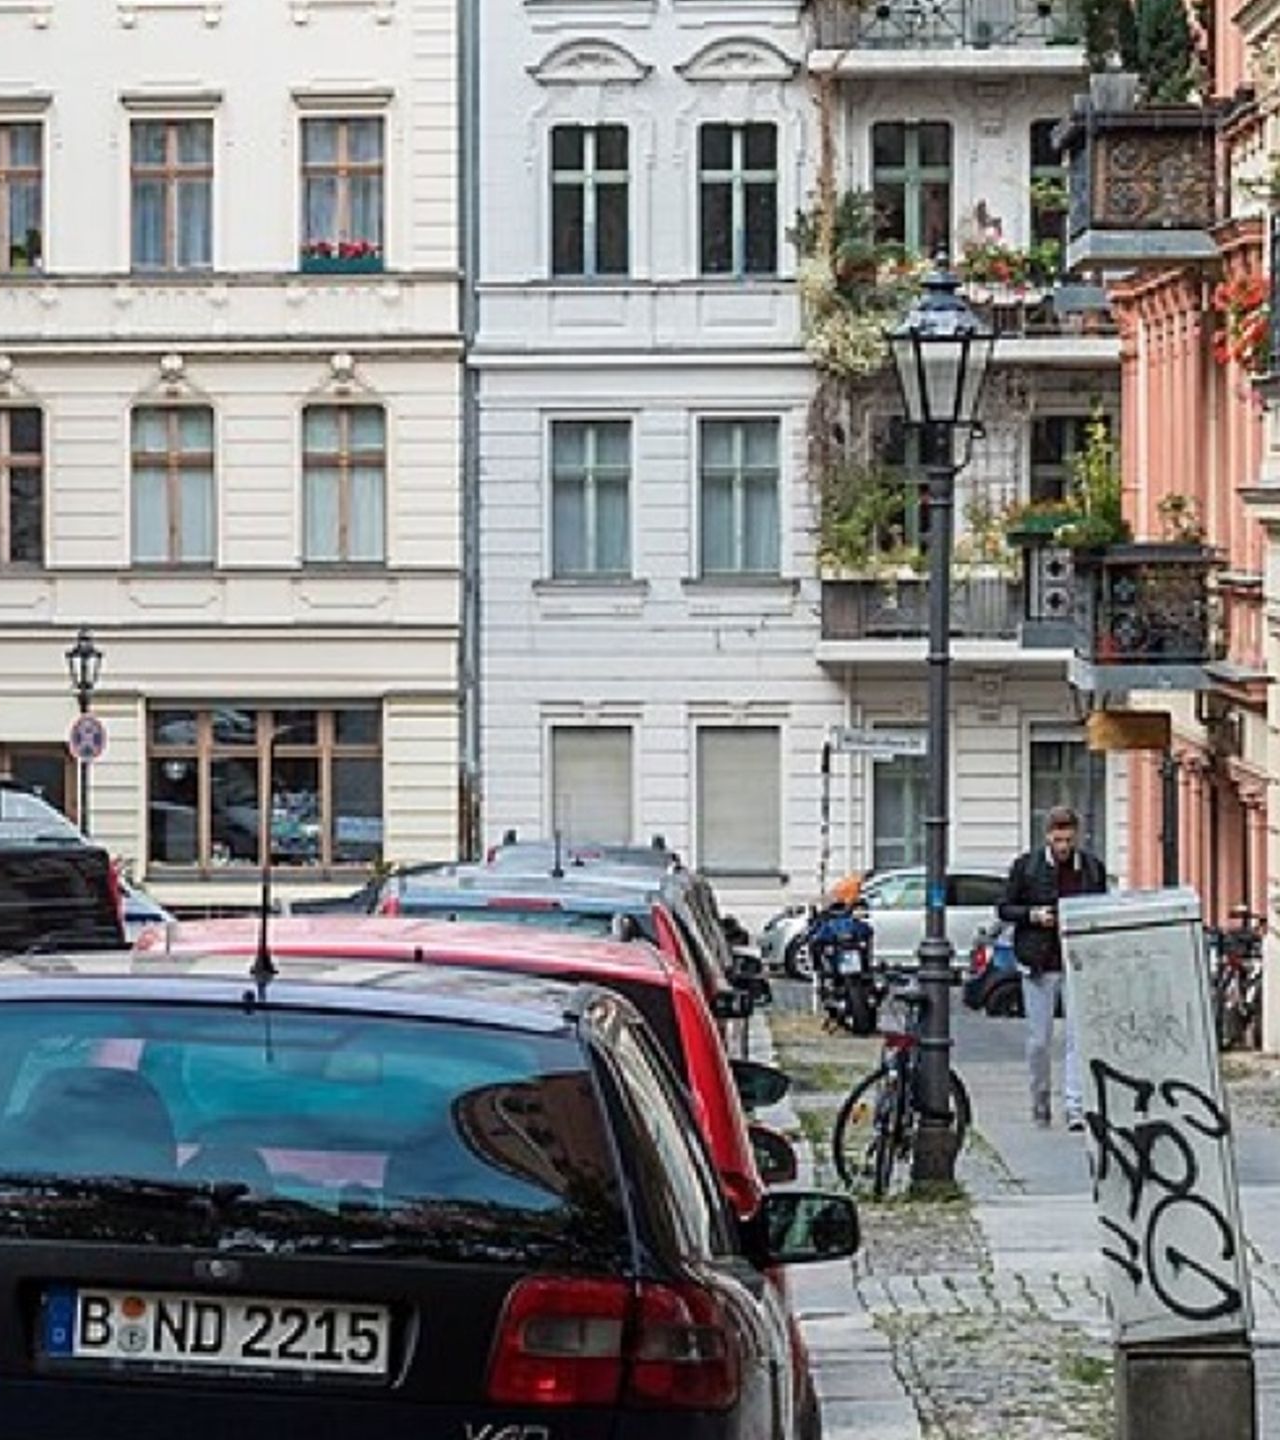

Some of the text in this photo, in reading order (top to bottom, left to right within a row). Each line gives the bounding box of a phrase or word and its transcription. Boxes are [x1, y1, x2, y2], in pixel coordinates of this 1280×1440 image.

[80, 1297, 380, 1364] B ND 2215
